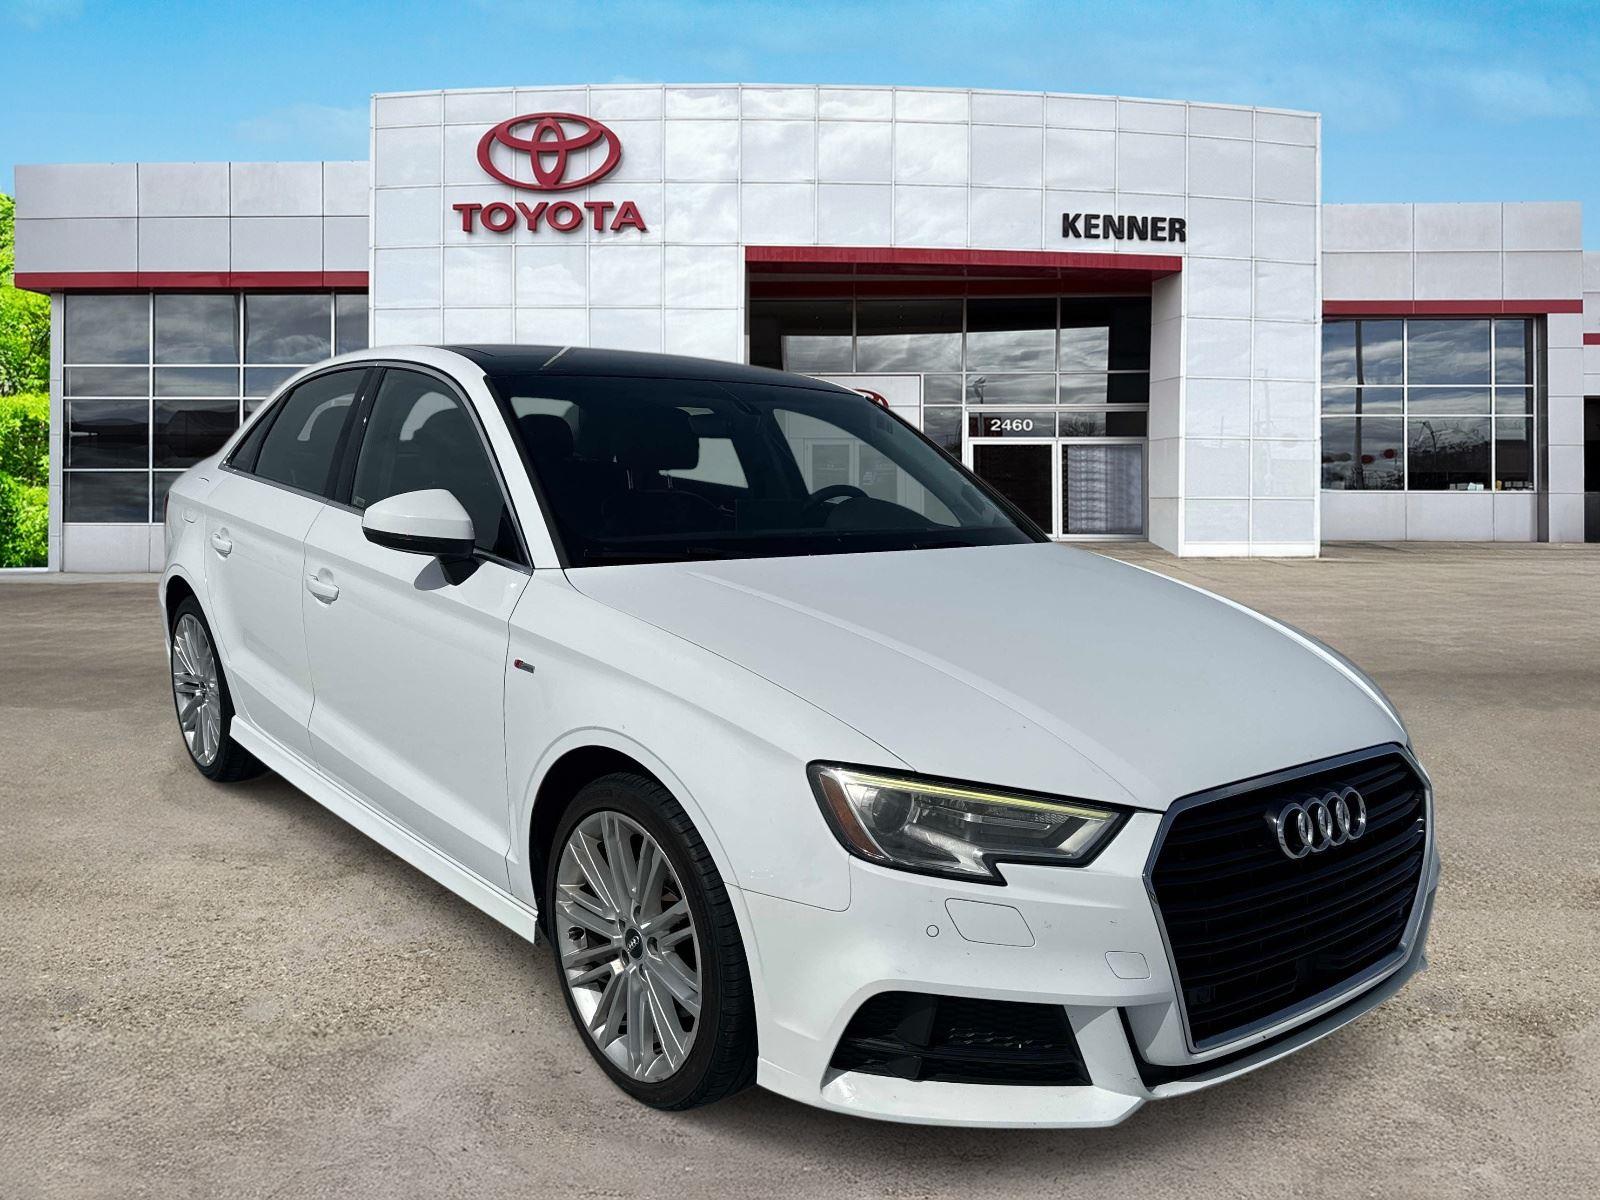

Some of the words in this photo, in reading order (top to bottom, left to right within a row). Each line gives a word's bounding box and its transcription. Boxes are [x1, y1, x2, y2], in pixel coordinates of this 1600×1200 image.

[452, 201, 646, 232] TOYOTA
[1062, 213, 1186, 242] KENNER
[990, 419, 1033, 431] 2460
